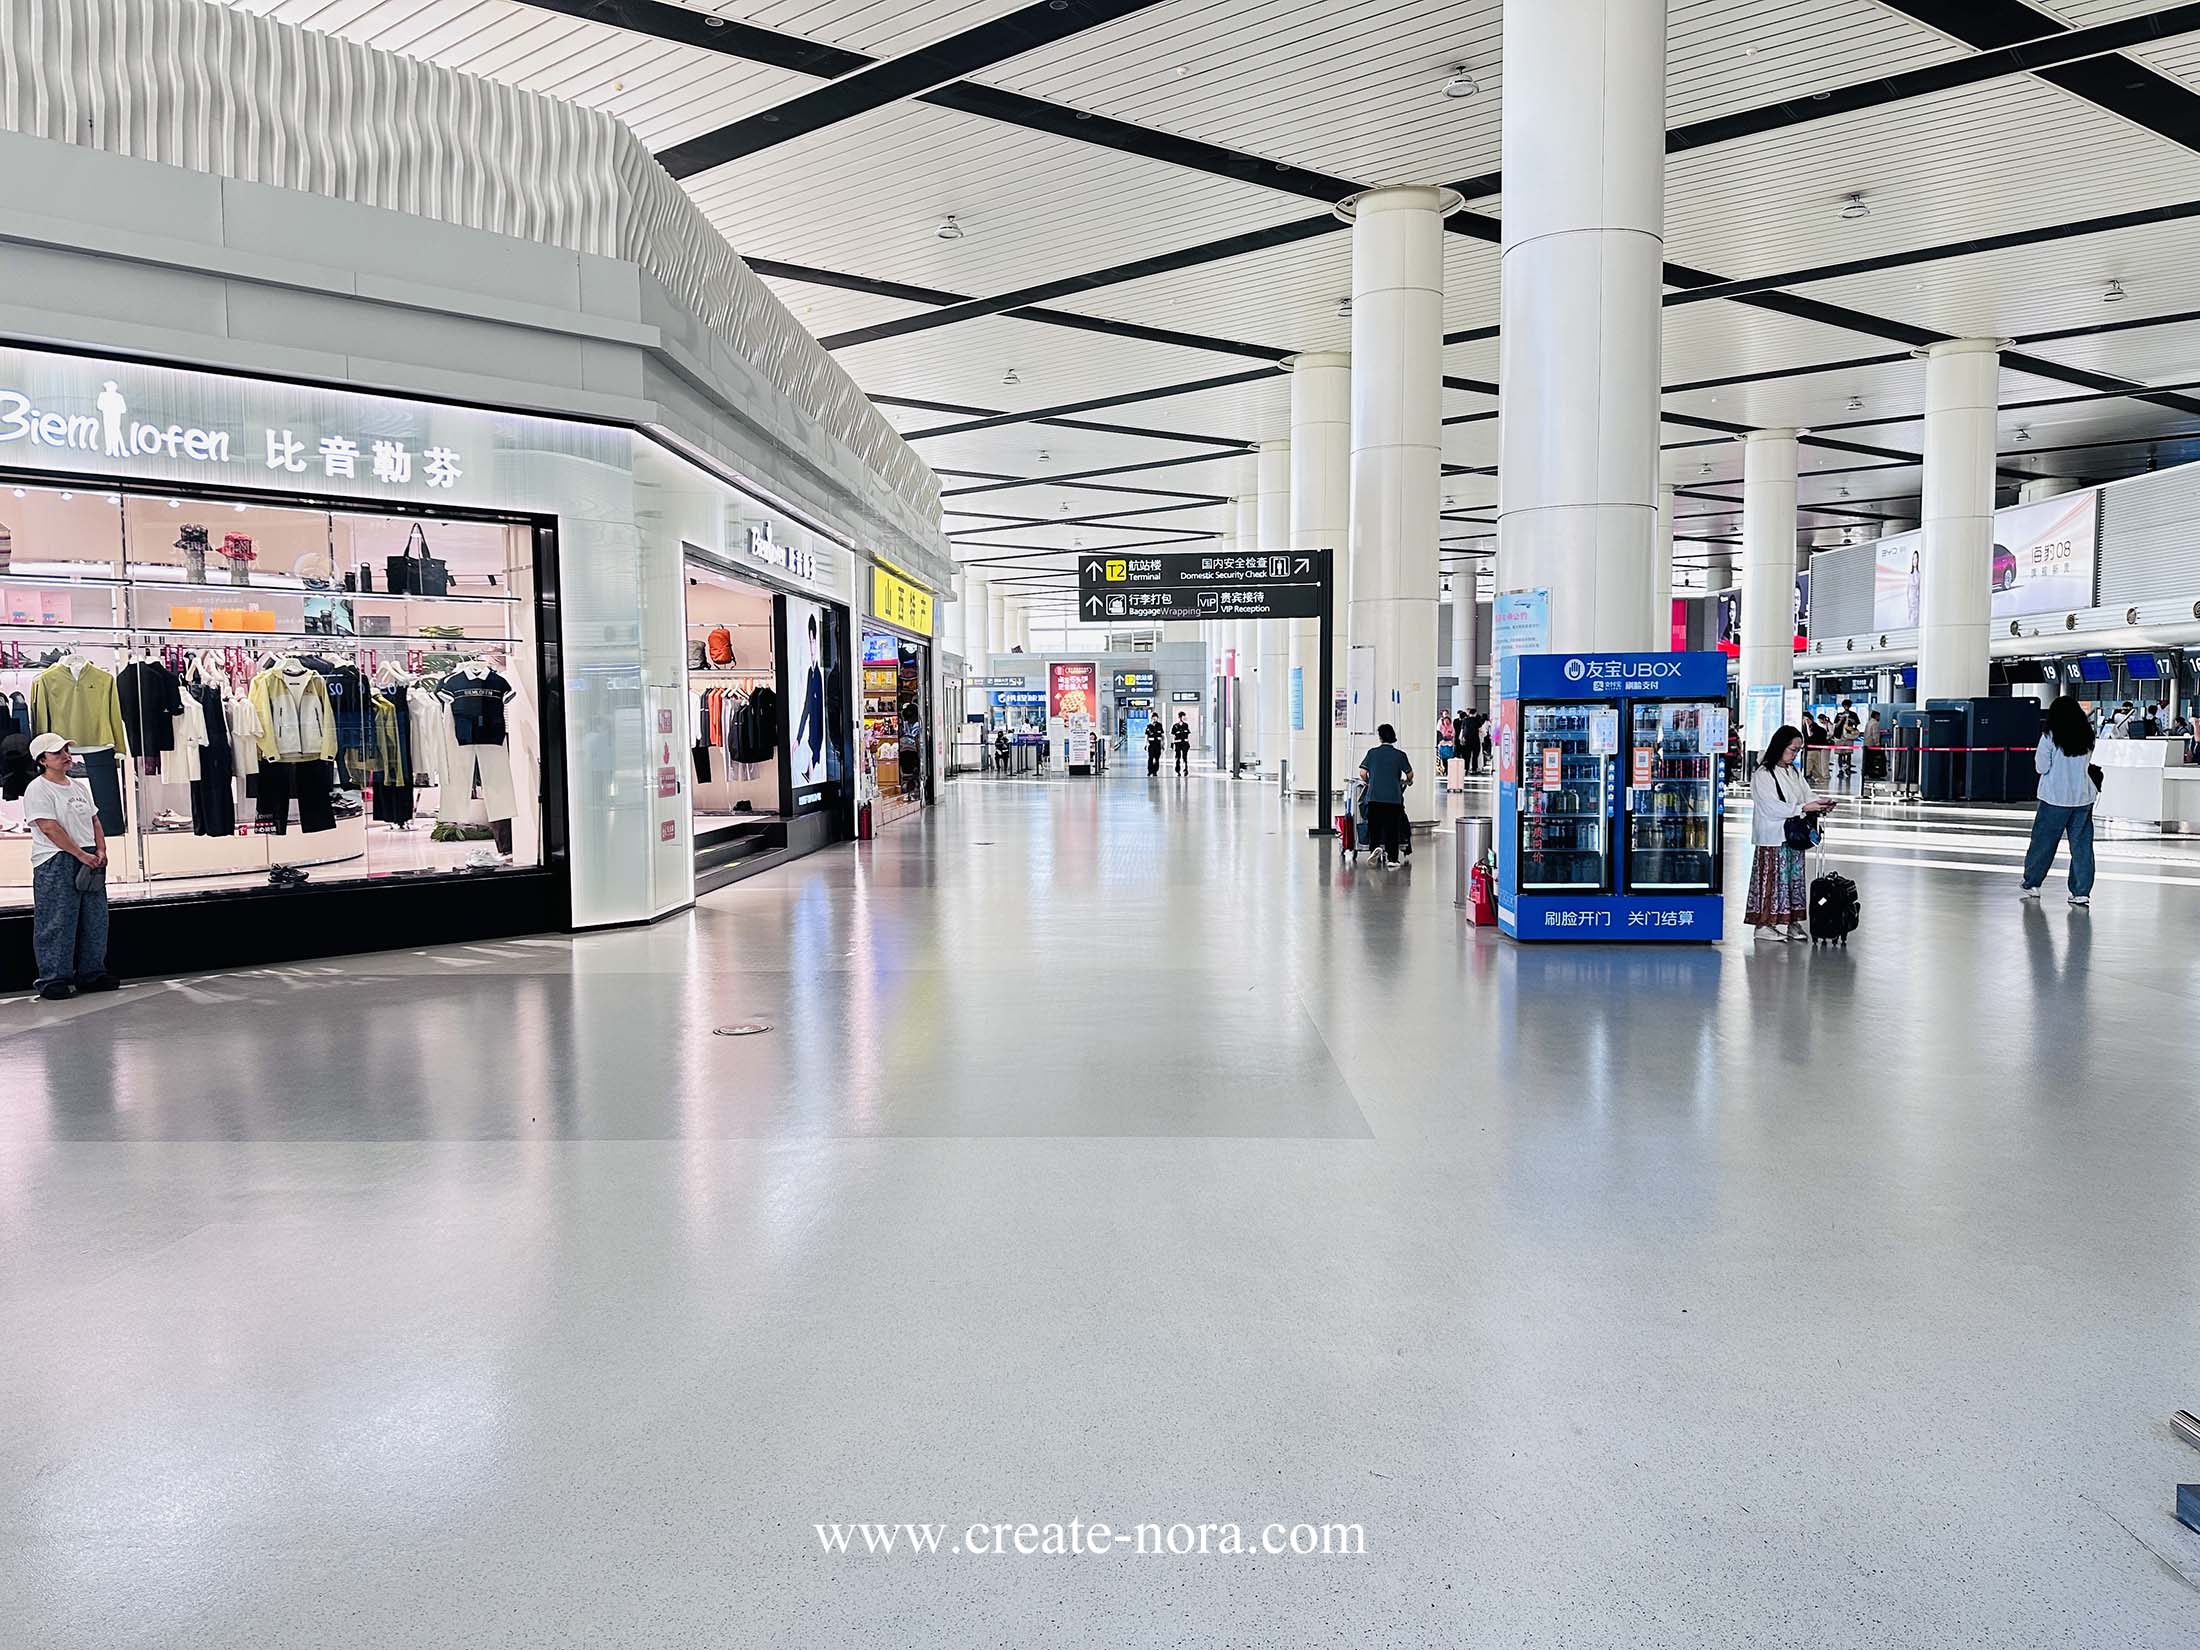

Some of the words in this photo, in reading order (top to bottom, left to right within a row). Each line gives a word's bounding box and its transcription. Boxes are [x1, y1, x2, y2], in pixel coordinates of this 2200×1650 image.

[265, 428, 464, 488] 比音勒芬
[1128, 559, 1162, 571] 航站楼
[1201, 557, 1268, 570] 国内安全检查
[1107, 564, 1125, 578] T2
[1128, 572, 1161, 581] Terminal
[1180, 571, 1214, 580] Domestic
[1215, 571, 1245, 580] Security
[1245, 570, 1267, 578] Check
[1128, 593, 1173, 606] 行李打包
[1200, 598, 1216, 608] VIP
[1220, 592, 1264, 604] 贵宾接待
[1221, 605, 1233, 613] VIP
[1234, 605, 1271, 614] Reception
[2067, 664, 2081, 678] 18
[2156, 658, 2170, 674] 17
[2043, 666, 2056, 680] 19
[1625, 681, 1659, 690] 刷脸支付
[1544, 911, 1611, 927] 刷脸开门
[1628, 910, 1695, 926] 关门结算
